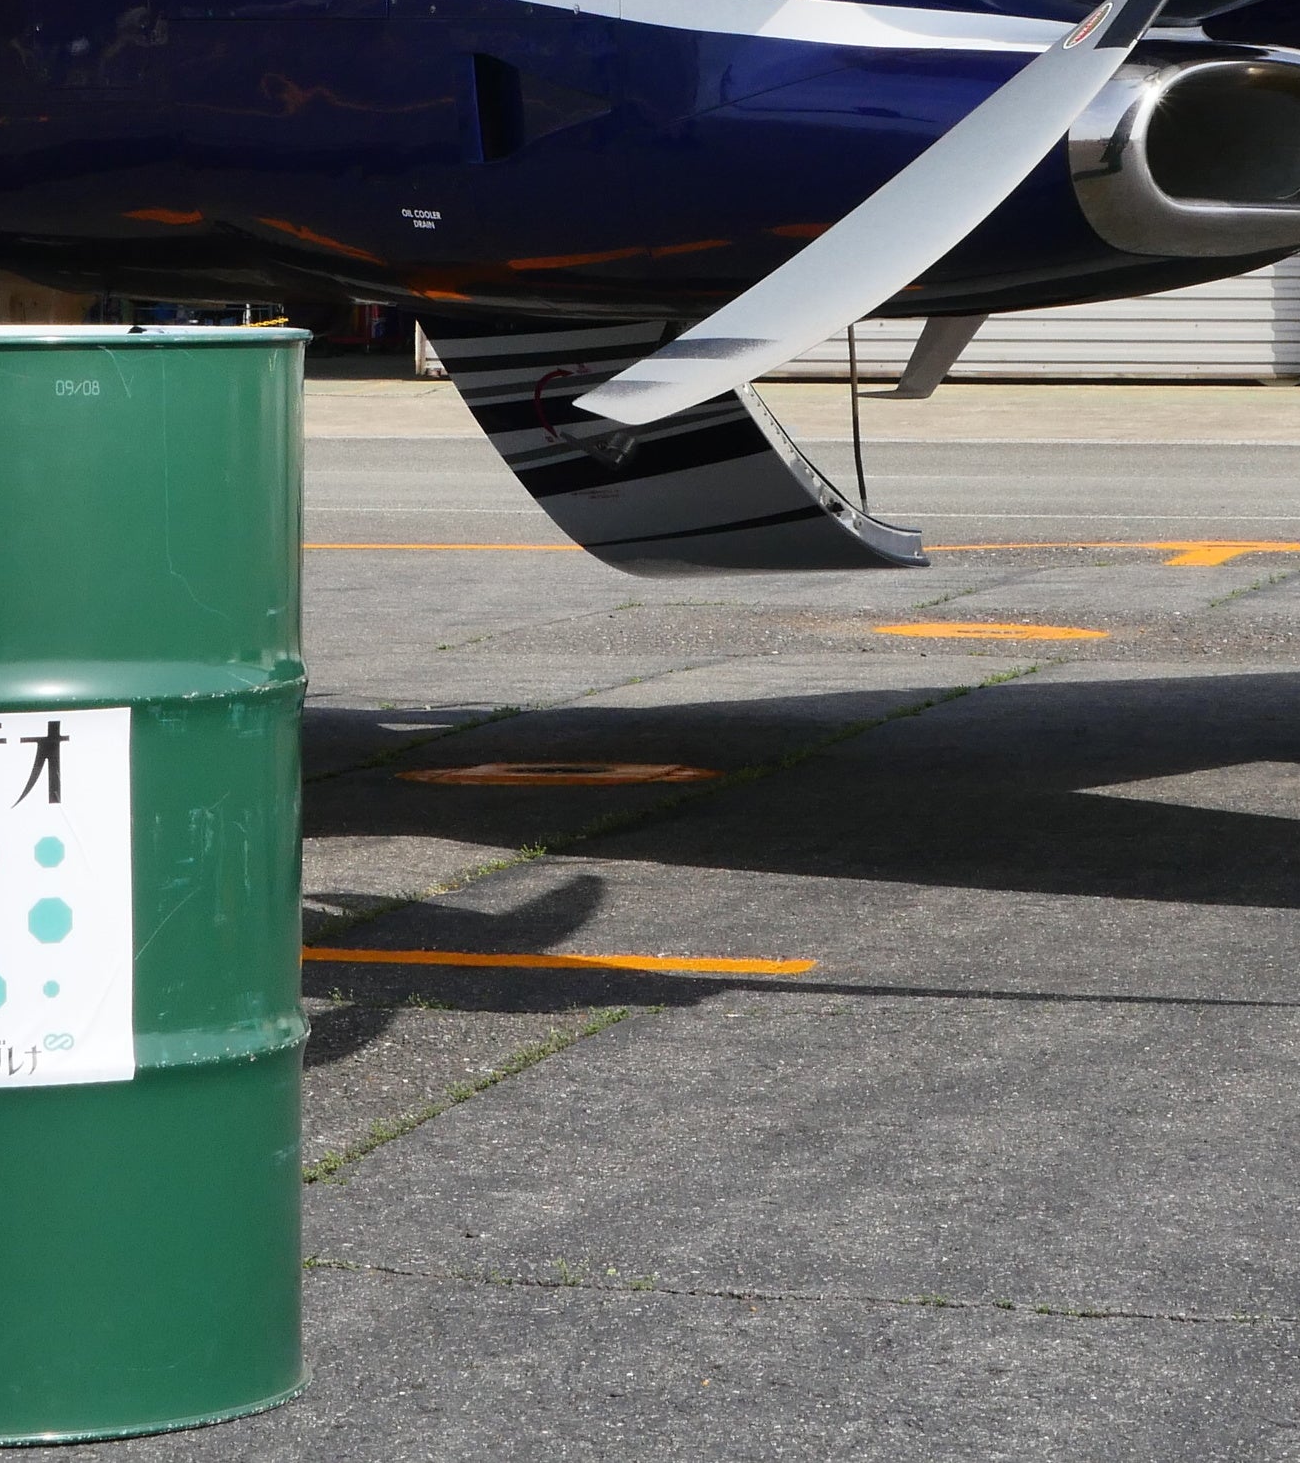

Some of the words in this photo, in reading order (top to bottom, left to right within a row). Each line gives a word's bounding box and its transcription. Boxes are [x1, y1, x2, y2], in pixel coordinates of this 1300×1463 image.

[401, 208, 414, 218] OIL
[414, 210, 442, 220] COOLER
[413, 220, 436, 229] DRAIN
[56, 380, 100, 396] 09/08
